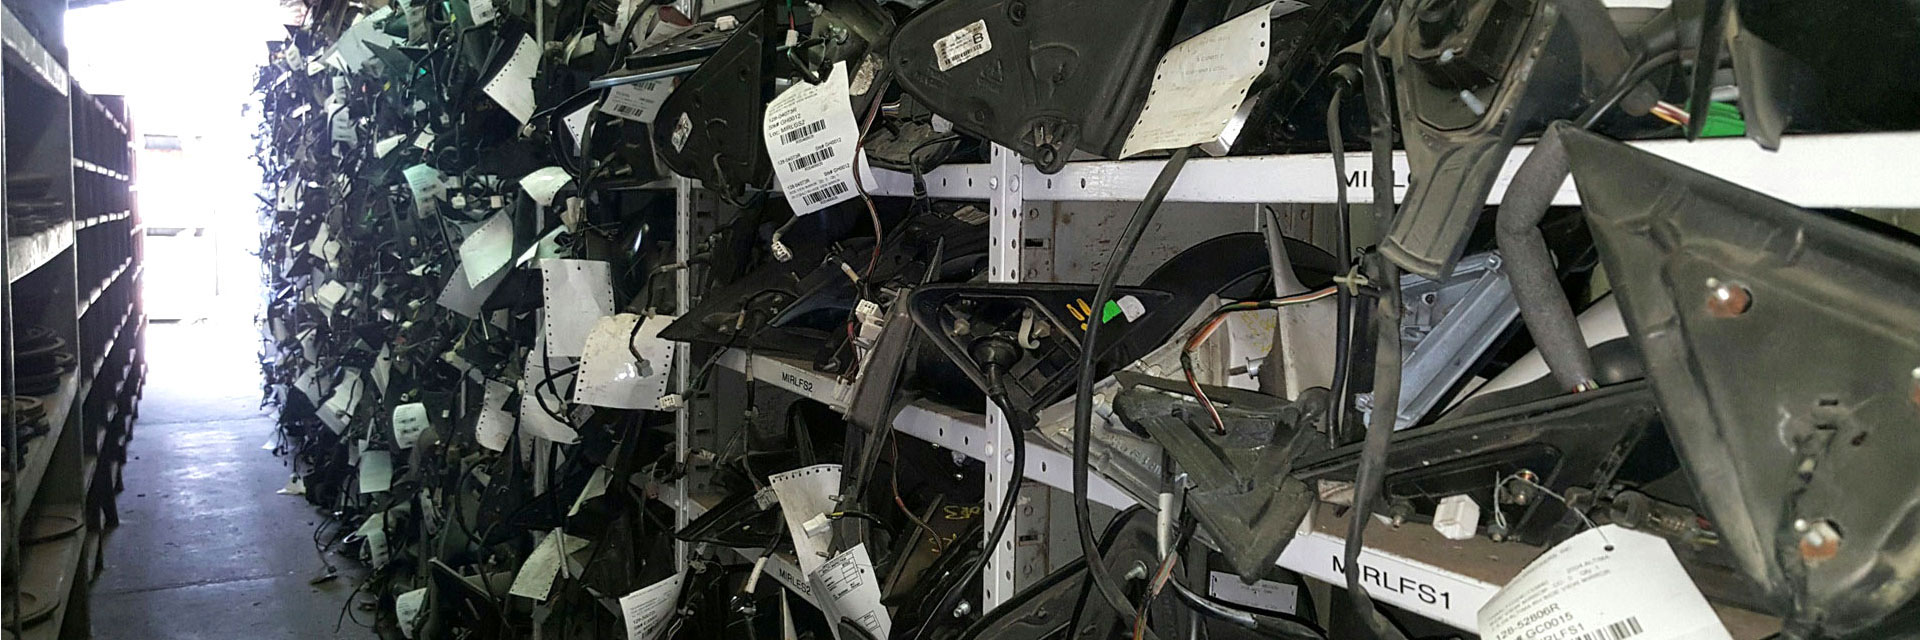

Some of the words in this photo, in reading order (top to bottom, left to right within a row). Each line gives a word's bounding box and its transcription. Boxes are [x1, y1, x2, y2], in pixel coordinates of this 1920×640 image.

[973, 32, 984, 44] B
[1345, 170, 1411, 188] MIL
[782, 372, 813, 392] MIRLFS2
[1332, 555, 1450, 609] MRLFS1
[1496, 602, 1561, 640] 128-52806R
[1525, 611, 1574, 639] GC0015
